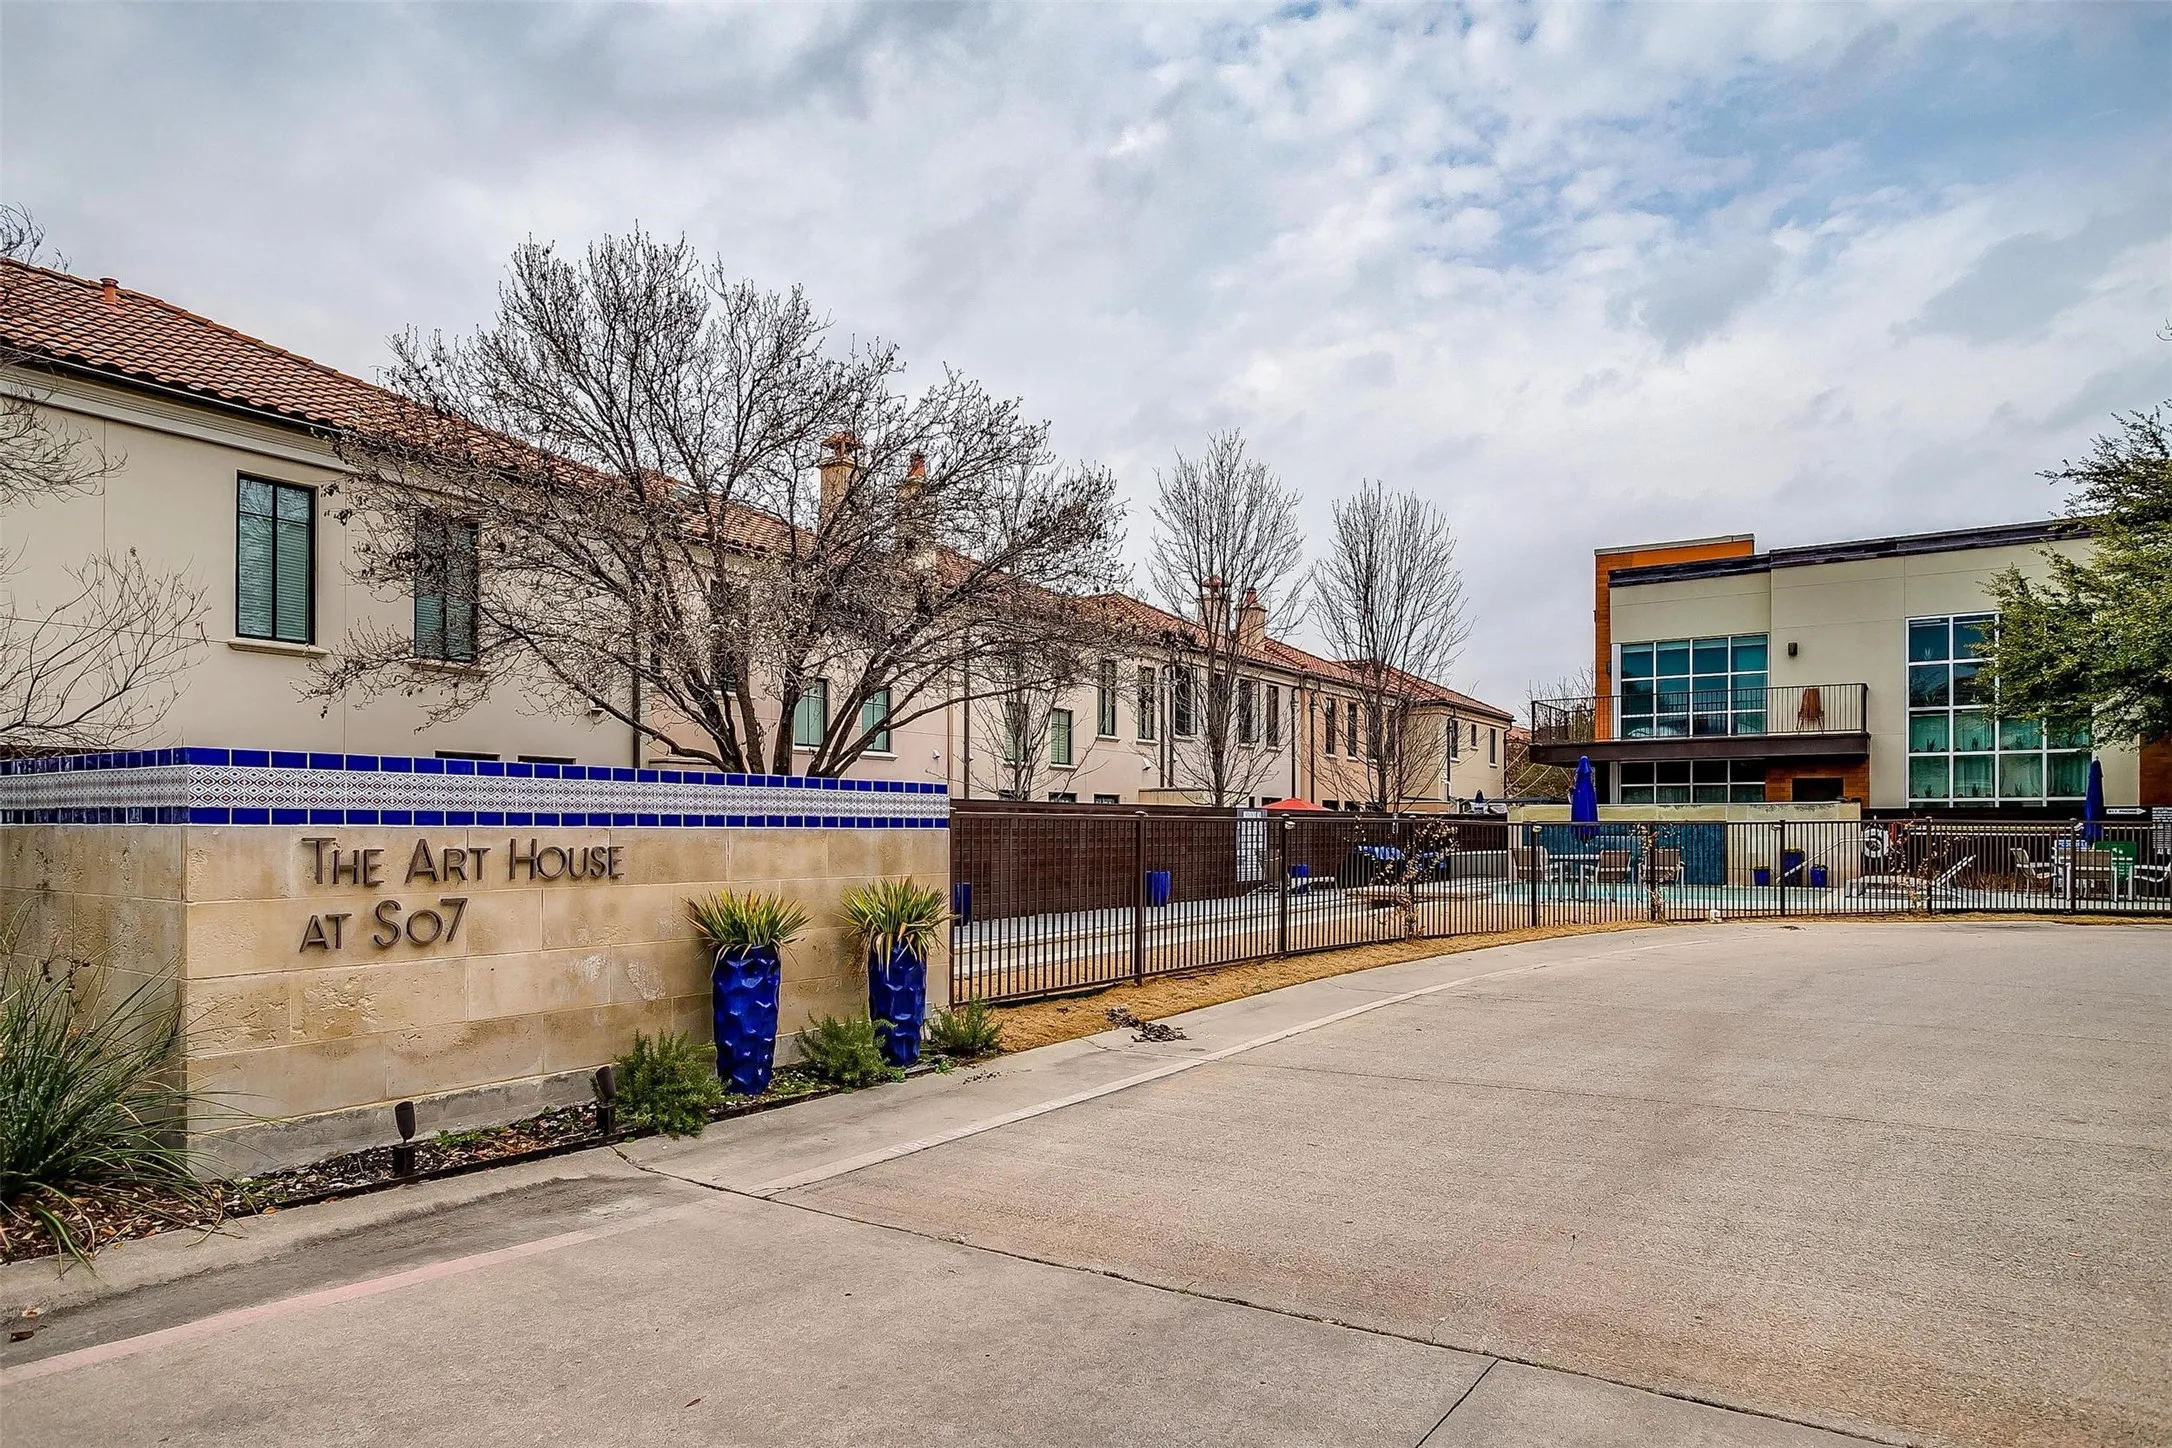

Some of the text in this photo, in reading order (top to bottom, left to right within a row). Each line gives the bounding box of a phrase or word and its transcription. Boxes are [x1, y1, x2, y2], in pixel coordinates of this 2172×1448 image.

[301, 837, 625, 886] THE ART HOUSE
[300, 913, 352, 952] AT
